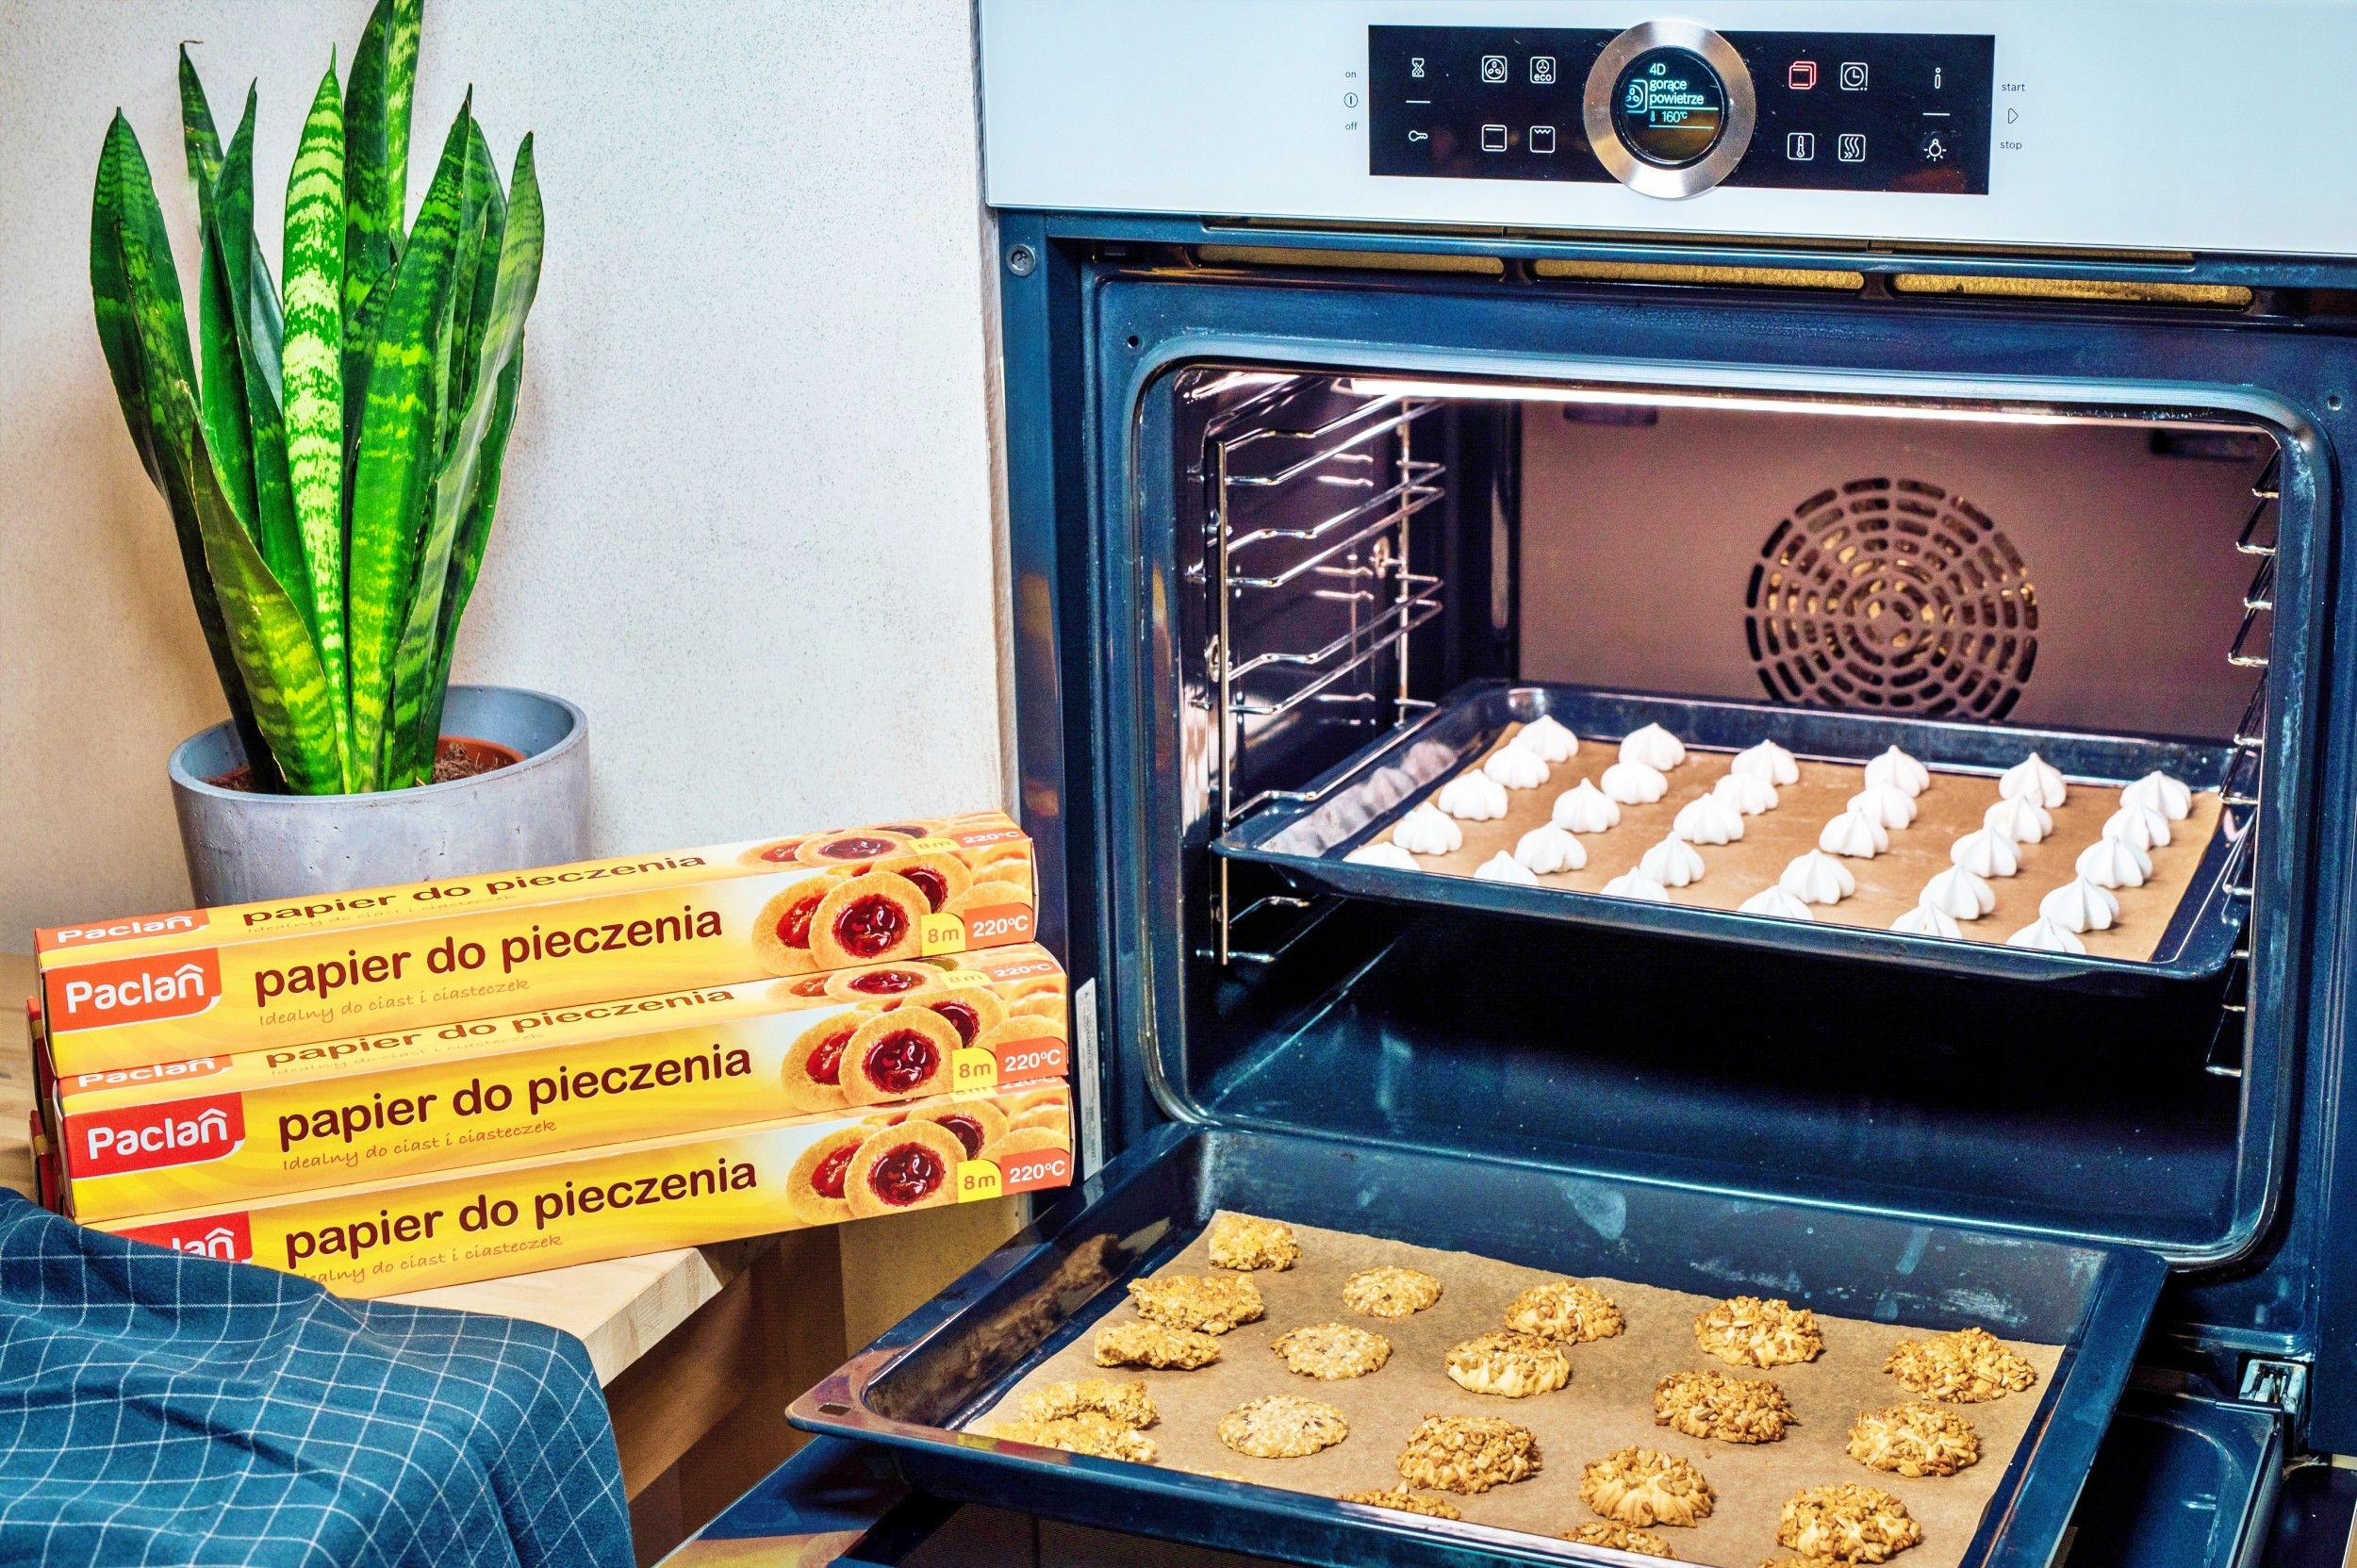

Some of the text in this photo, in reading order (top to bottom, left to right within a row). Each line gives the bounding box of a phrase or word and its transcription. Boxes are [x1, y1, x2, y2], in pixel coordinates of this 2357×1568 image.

[1649, 63, 1666, 75] 4D
[1649, 80, 1687, 91] gorące
[2001, 83, 2025, 91] start
[1649, 92, 1704, 106] powietrze
[1661, 110, 1688, 123] 160°C
[1344, 122, 1358, 130] off
[2000, 140, 2022, 151] stop
[243, 856, 706, 926] papier do pieczenia
[255, 905, 723, 1008] papier do pieczenia
[259, 978, 530, 1026] Idealny do ciast i ciasteczek
[266, 990, 734, 1067] papier do pieczenia
[278, 1043, 752, 1153] papier do pieczenia
[283, 1119, 557, 1170] Idealny do ciast i ciasteczek
[286, 1210, 444, 1270] papier
[458, 1194, 519, 1232] do
[535, 1157, 757, 1230] pieczenia
[304, 1234, 563, 1283] ealny do ciast i ciasteczek
